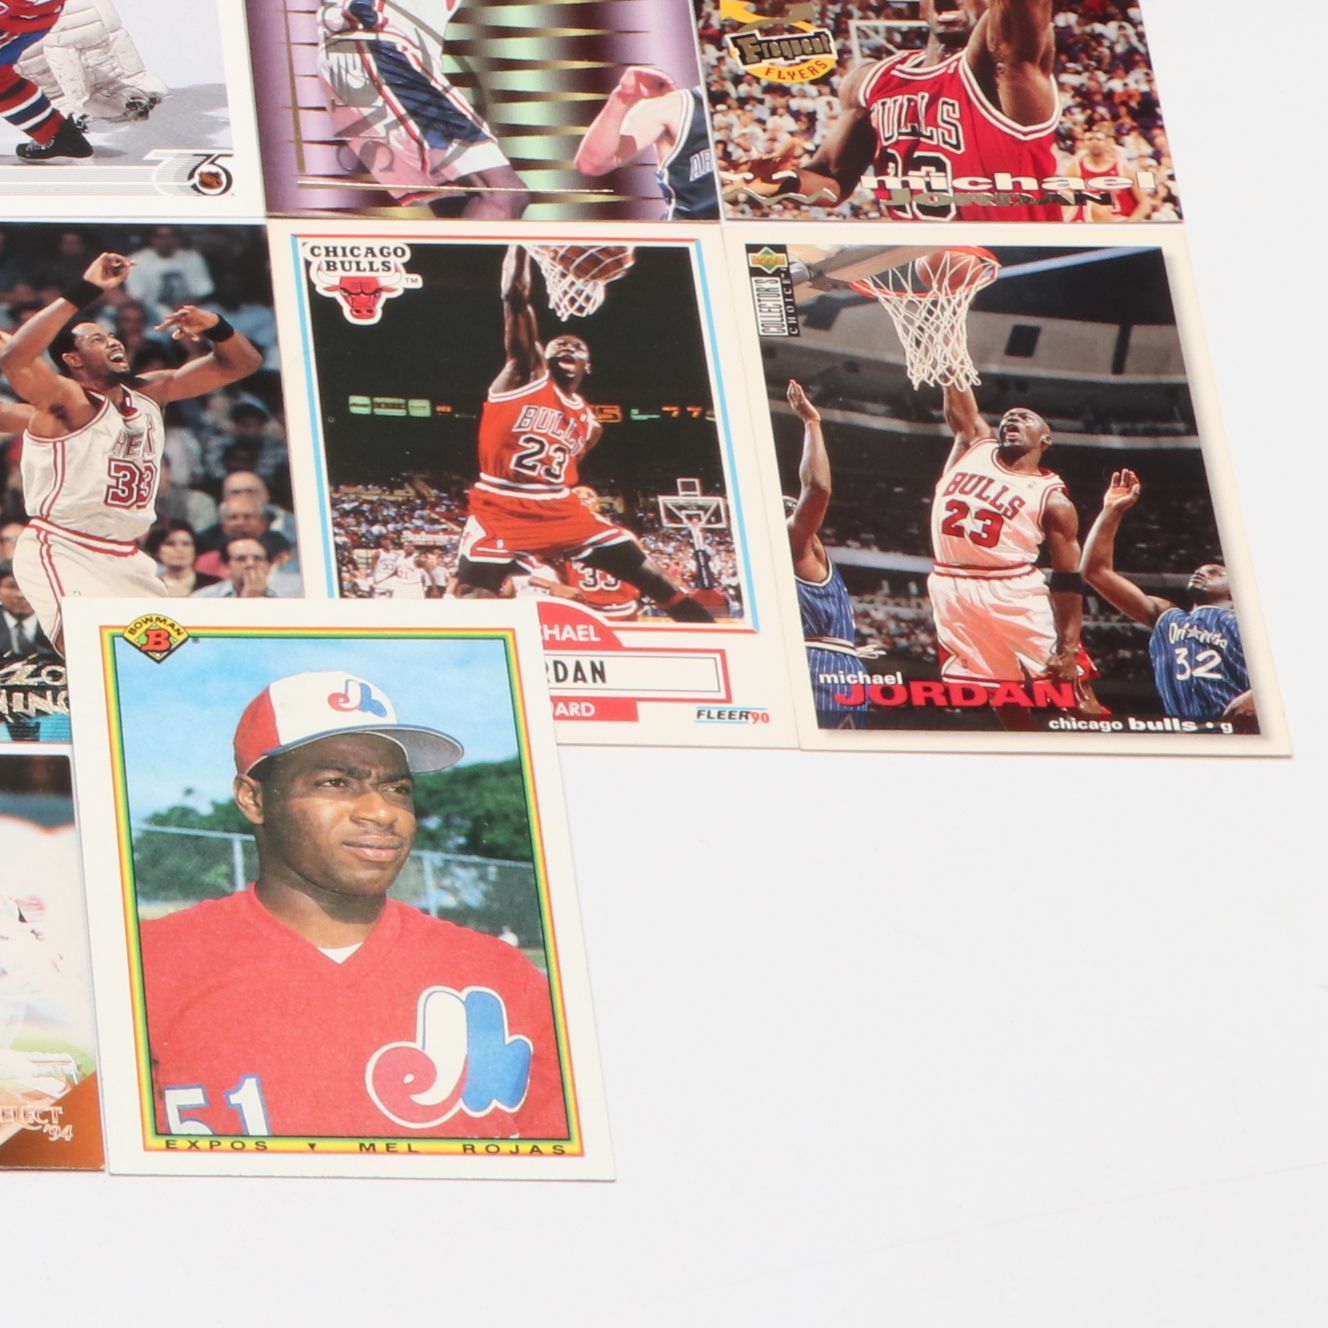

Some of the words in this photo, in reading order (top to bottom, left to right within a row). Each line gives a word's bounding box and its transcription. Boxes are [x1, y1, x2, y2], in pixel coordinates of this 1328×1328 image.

[734, 30, 838, 66] Frequent
[763, 58, 829, 83] FLYERS
[859, 171, 1157, 193] michael
[309, 245, 407, 260] CHICAGO
[324, 259, 393, 273] BULLS
[511, 434, 570, 481] 23
[103, 457, 157, 511] 33
[942, 471, 1028, 522] BULLS
[940, 499, 1006, 550] 23
[125, 614, 188, 639] BOWMAN
[543, 624, 602, 642] HAEL
[140, 627, 173, 652] B
[1174, 646, 1225, 682] 32
[818, 670, 904, 686] michael
[832, 683, 1078, 710] JORDAN
[1048, 716, 1124, 733] chicago
[1129, 716, 1199, 733] bulls
[165, 1139, 269, 1152] EXPOS
[358, 1142, 420, 1154] MEL
[462, 1143, 567, 1156] ROJAS
